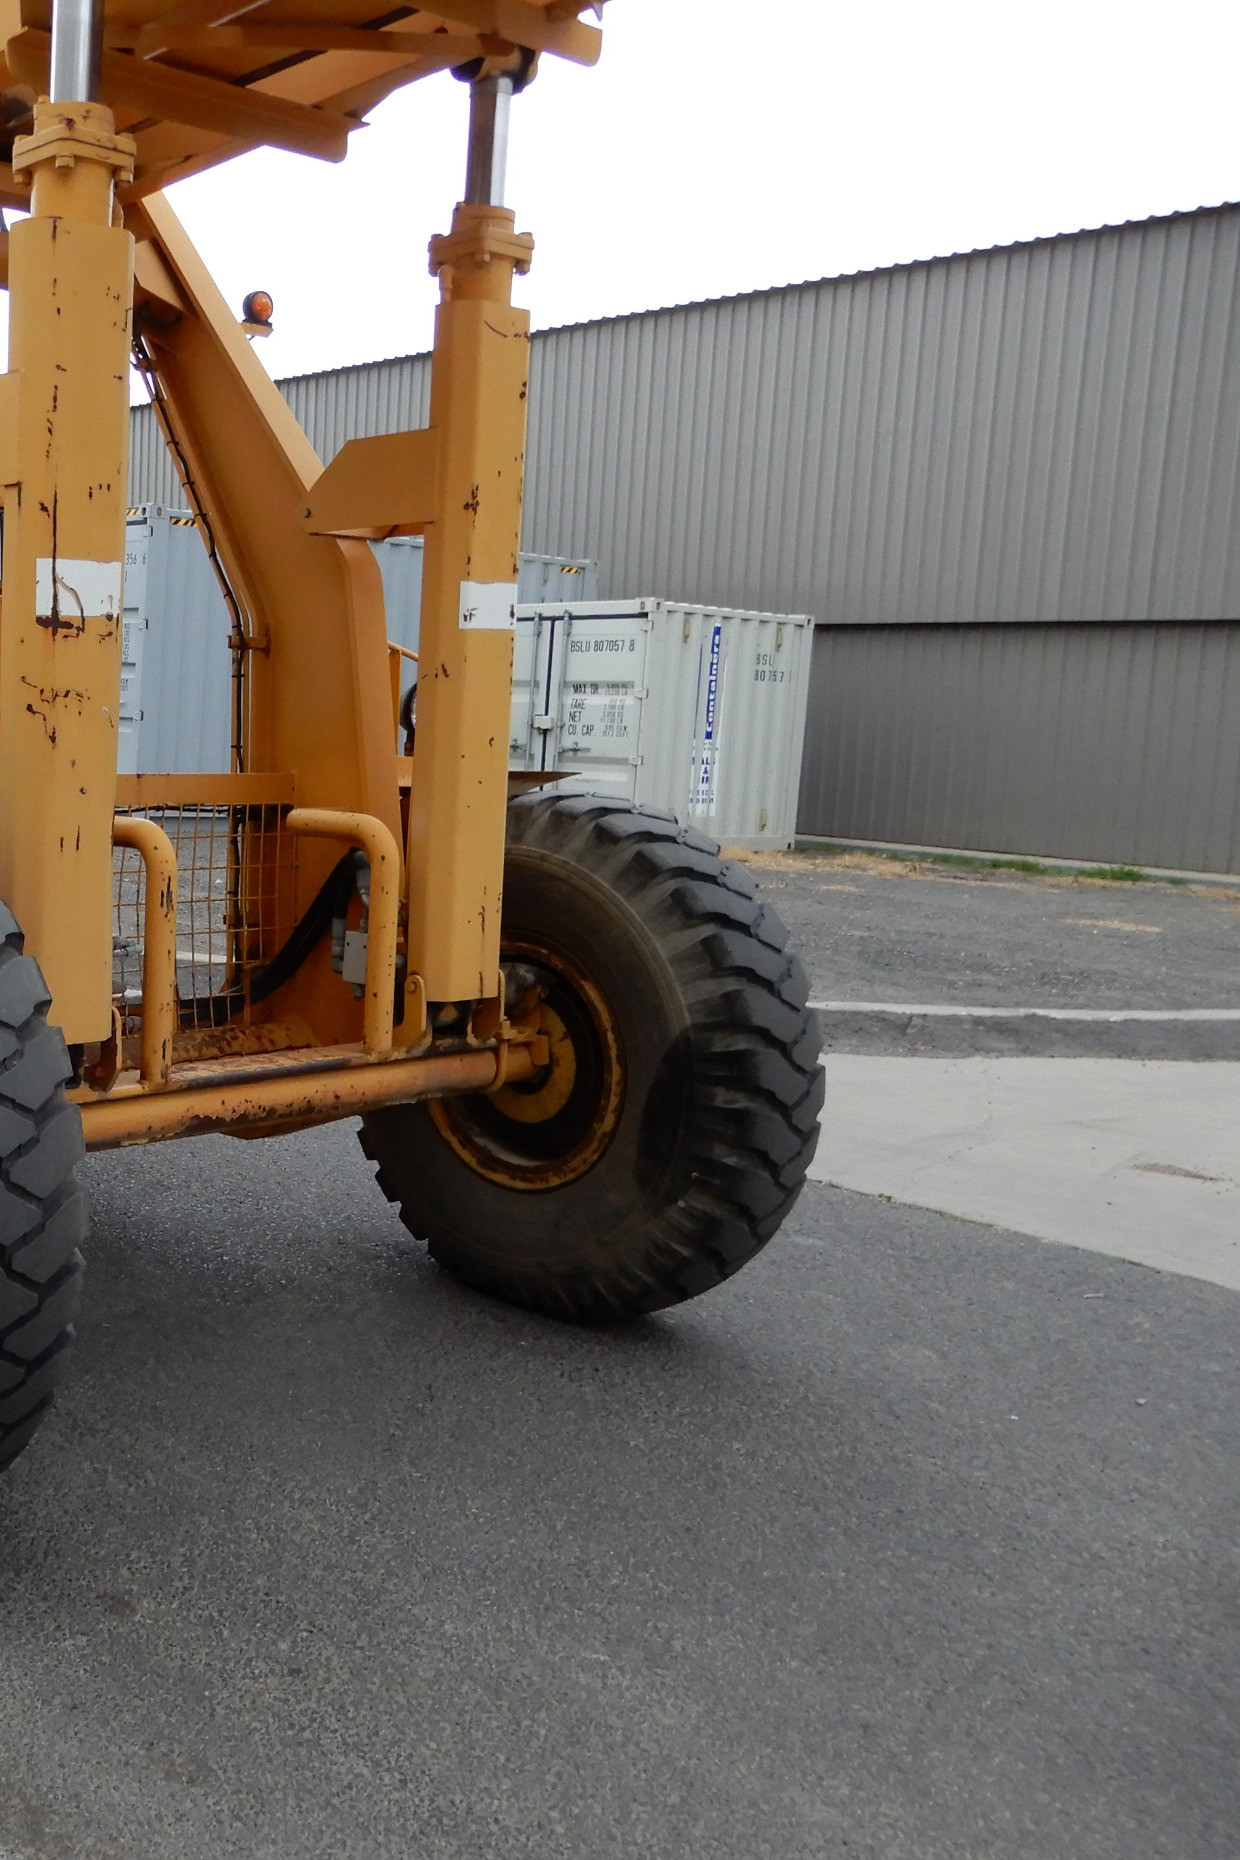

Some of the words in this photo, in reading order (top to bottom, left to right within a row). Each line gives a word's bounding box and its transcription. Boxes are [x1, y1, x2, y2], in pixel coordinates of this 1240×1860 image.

[570, 640, 591, 653] BSLU
[593, 639, 625, 652] 807057
[629, 639, 635, 652] 8
[572, 684, 587, 694] MAX
[570, 698, 588, 710] TARE
[568, 711, 582, 722] NET
